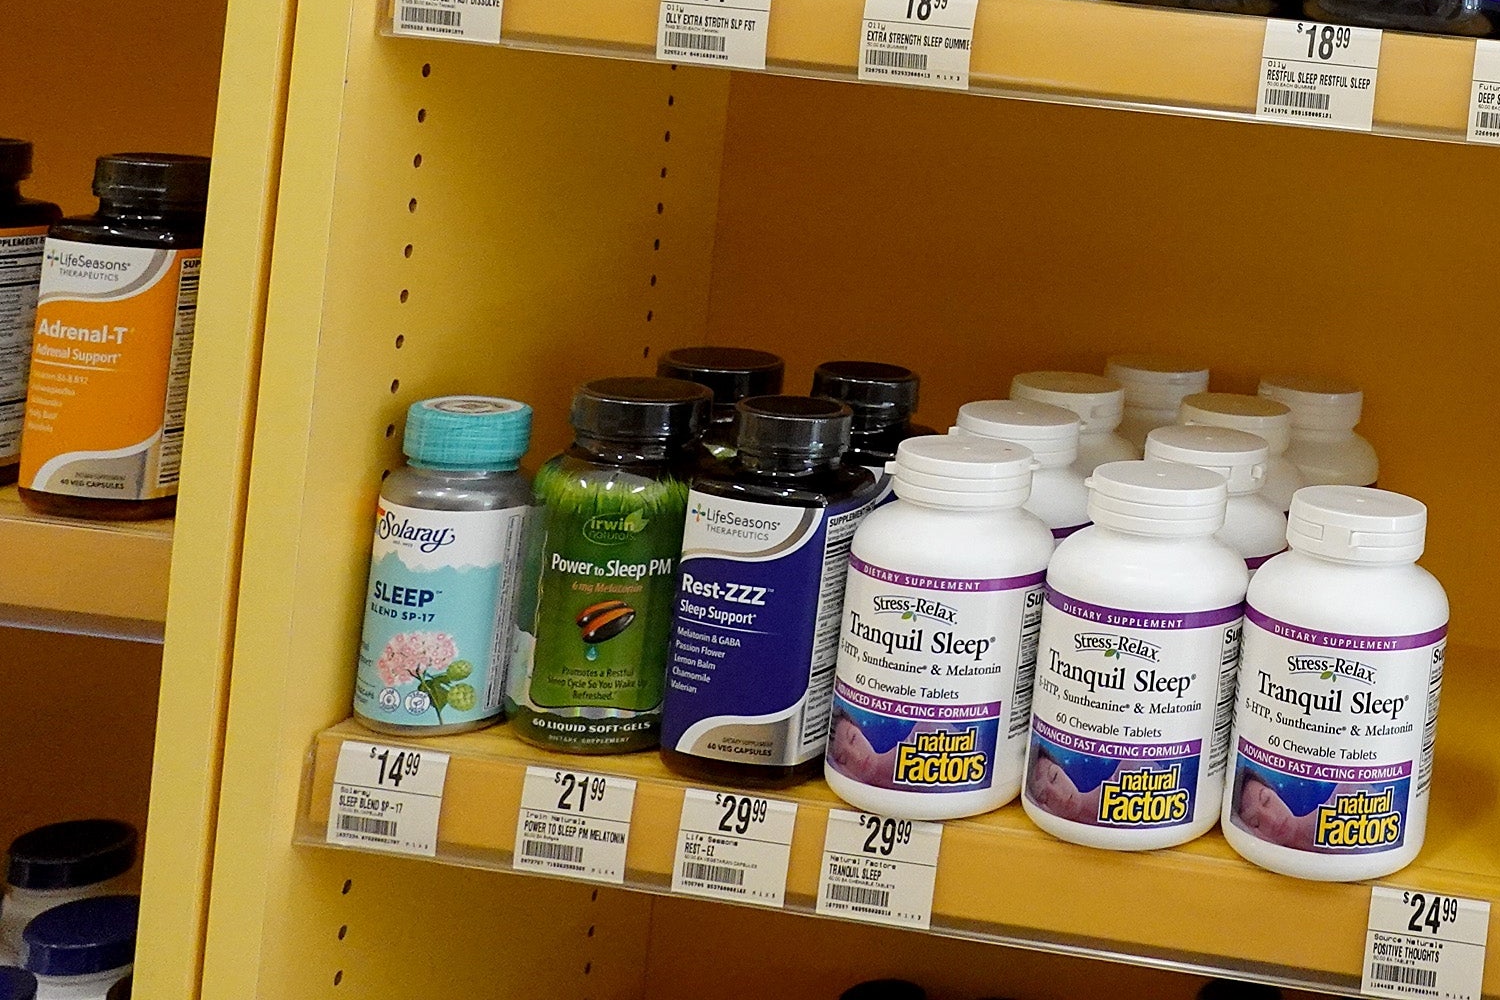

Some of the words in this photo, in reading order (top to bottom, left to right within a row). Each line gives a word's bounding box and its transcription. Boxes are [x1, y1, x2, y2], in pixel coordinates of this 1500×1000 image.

[1267, 70, 1295, 84] RESTFUL
[1297, 73, 1318, 85] SLEEP
[1319, 75, 1348, 87] RESTFUL
[1350, 77, 1370, 90] SLEEP
[1478, 92, 1495, 105] DEEP
[38, 319, 128, 344] Adrenal-T
[379, 511, 455, 553] Solaray
[706, 524, 768, 541] THERAPEUTICS
[552, 554, 593, 575] Power
[594, 564, 604, 576] to
[605, 558, 646, 578] Sleep
[648, 560, 671, 575] PM
[374, 581, 434, 608] SLEEP
[682, 574, 767, 606] Rest-ZZZ
[371, 603, 398, 618] BLEND
[401, 610, 435, 623] SP-17
[680, 601, 717, 623] Sleep
[1274, 624, 1316, 644] DIETARY
[1322, 637, 1398, 649] SUPPLEMENT
[1258, 670, 1341, 715] Tranquil
[1351, 690, 1404, 720] Sleep
[532, 718, 544, 727] 60
[546, 720, 586, 732] LIQUID
[589, 722, 651, 732] SOFT-GELS
[1268, 735, 1280, 748] 60
[1283, 740, 1335, 761] Chewable
[1339, 749, 1377, 761] Tablets
[1243, 744, 1285, 770] ADVANCED
[1288, 759, 1312, 774] FAST
[1315, 764, 1354, 779] ACTING
[1358, 765, 1403, 778] FORMULA
[1338, 793, 1391, 813] natural
[1318, 807, 1400, 845] Factors
[829, 863, 860, 878] TRANQUIL
[862, 868, 881, 881] SLEEP
[1373, 942, 1402, 959] POSITIVE
[1405, 946, 1439, 963] THOUGHTS
